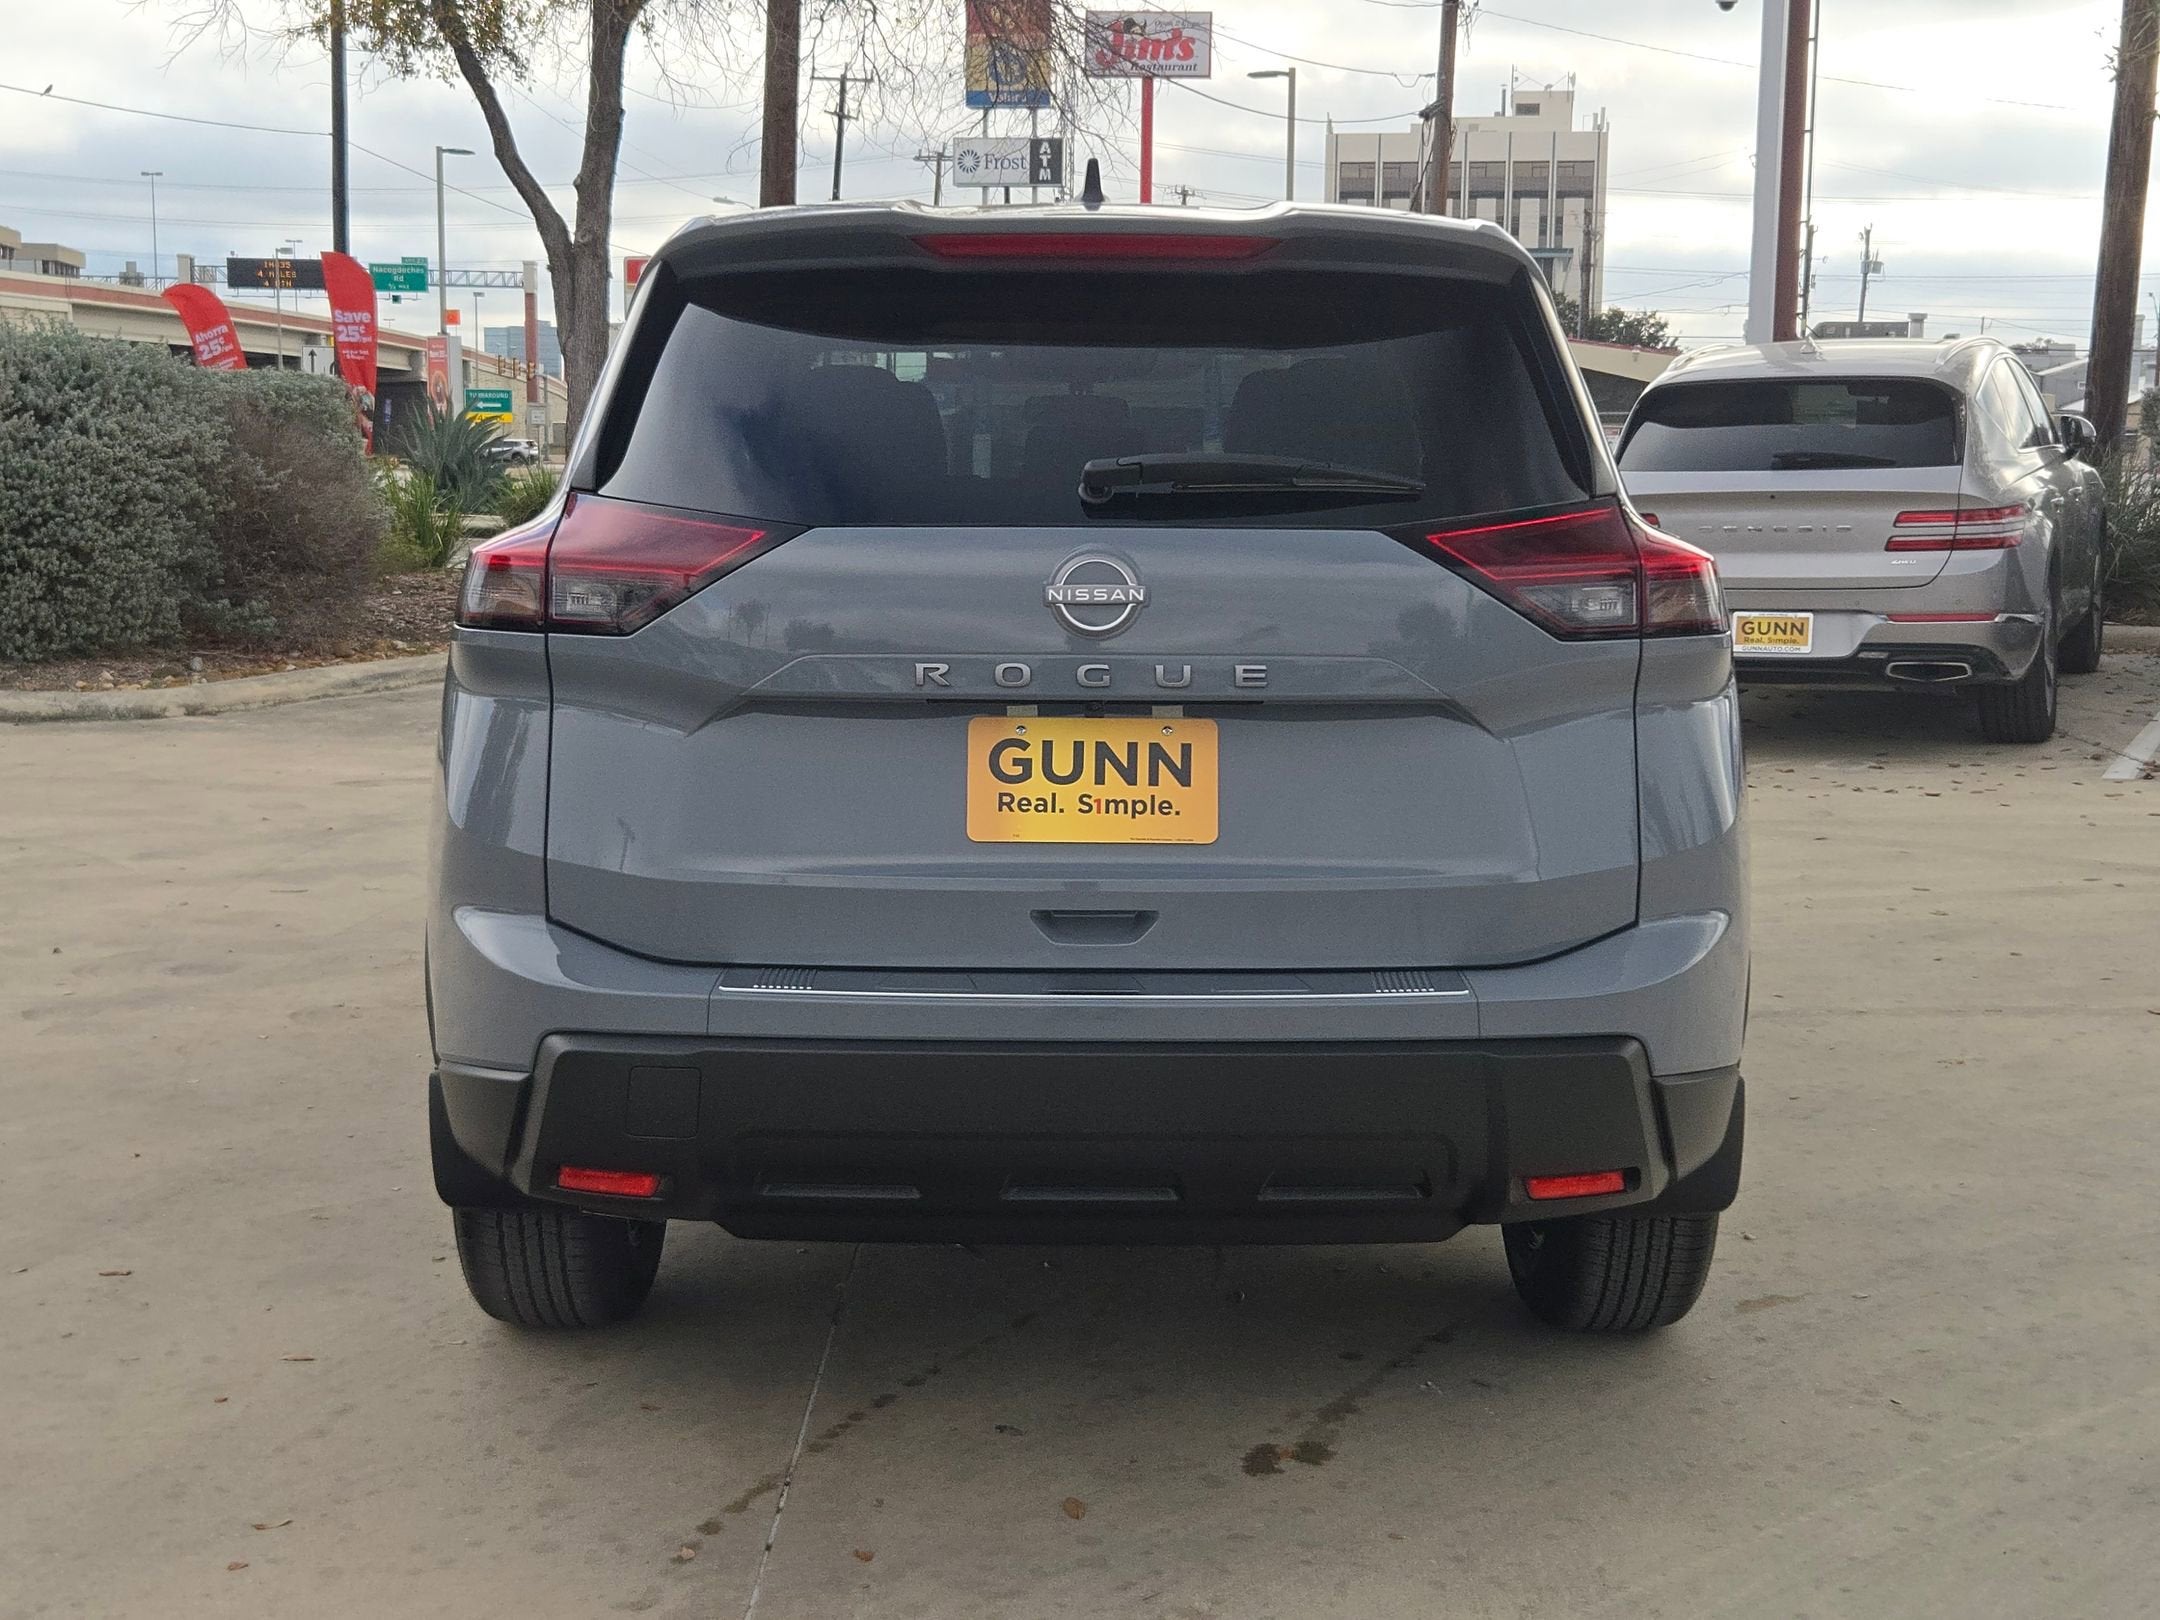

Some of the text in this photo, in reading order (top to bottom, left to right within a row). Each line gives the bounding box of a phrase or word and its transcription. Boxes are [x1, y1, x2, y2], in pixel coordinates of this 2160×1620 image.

[1095, 18, 1196, 69] Jim's
[984, 153, 1027, 170] Frost
[268, 270, 298, 279] MLES
[372, 265, 425, 275] Nacogdoches
[334, 309, 372, 323] Save
[194, 324, 229, 344] Ahorra
[1047, 588, 1146, 602] NISSAN
[1741, 620, 1805, 637] GUNN
[914, 662, 1269, 689] ROGUE
[988, 737, 1193, 788] GUNN
[997, 791, 1065, 814] Real.
